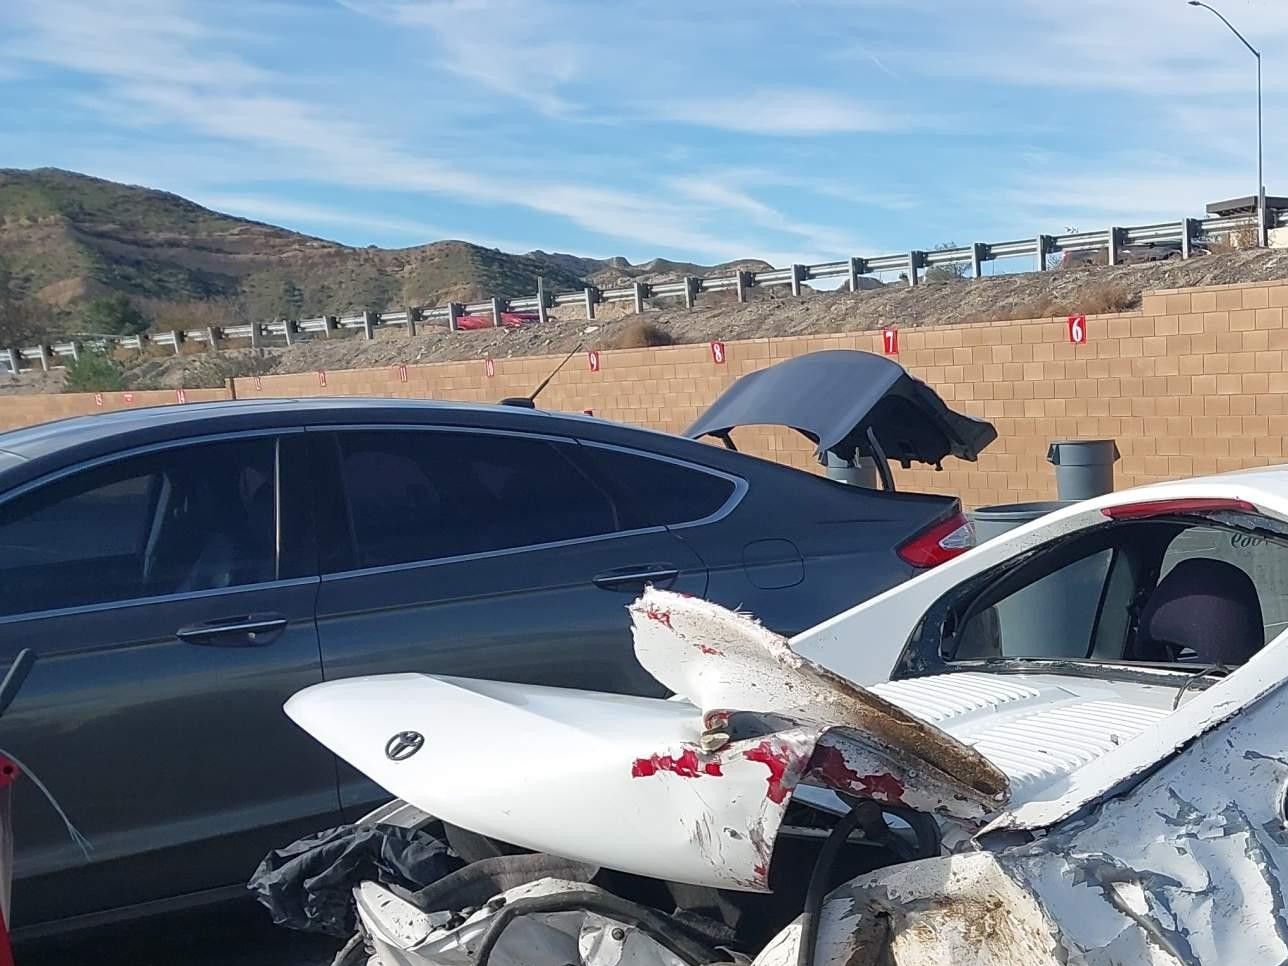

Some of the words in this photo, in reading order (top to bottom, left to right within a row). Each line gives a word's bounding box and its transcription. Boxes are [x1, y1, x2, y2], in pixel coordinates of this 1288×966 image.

[1071, 317, 1084, 342] 6
[885, 331, 894, 353] 7
[590, 353, 597, 371] 9
[713, 343, 722, 362] 8
